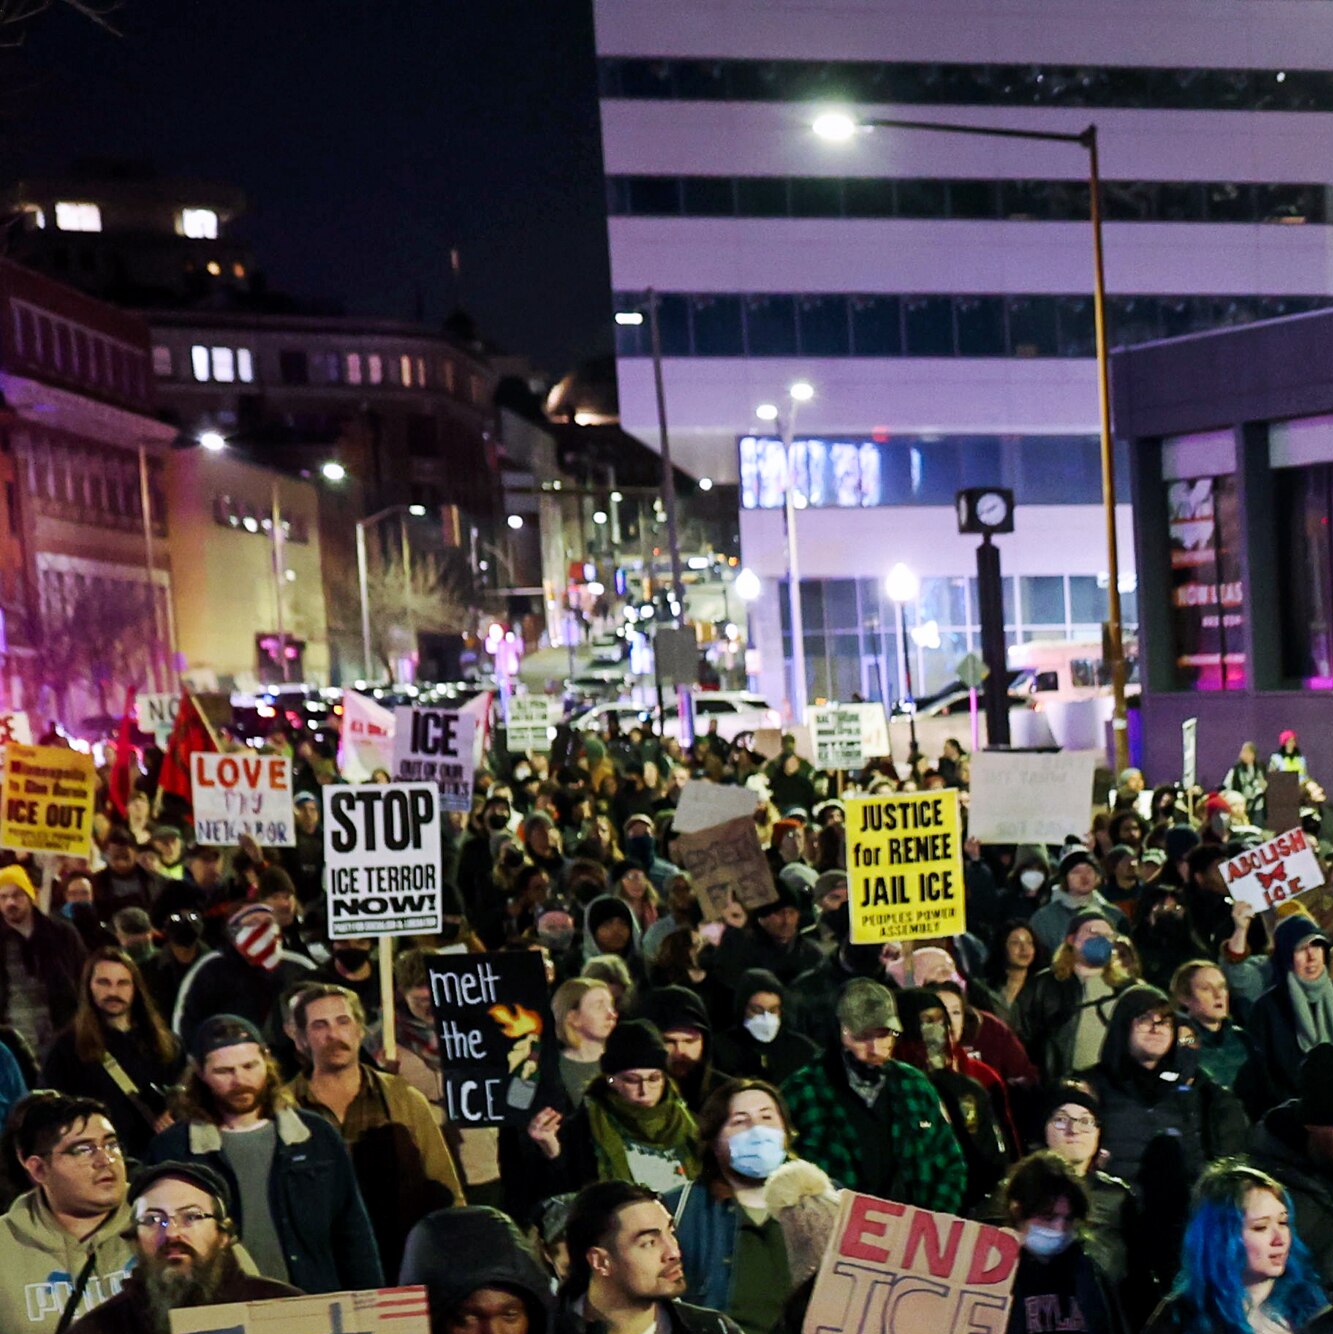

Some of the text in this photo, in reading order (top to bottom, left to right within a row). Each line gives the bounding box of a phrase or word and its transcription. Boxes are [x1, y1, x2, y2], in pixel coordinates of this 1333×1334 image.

[411, 710, 460, 758] ICE
[197, 757, 288, 792] LOVE
[8, 799, 87, 831] ICE OUT
[329, 789, 435, 854] STOP
[860, 800, 944, 832] JUSTICE
[854, 832, 952, 868] for RENEE
[1228, 829, 1307, 884] ABOLISH
[331, 863, 437, 896] ICE TERROR
[861, 871, 955, 908] JAIL ICE
[332, 894, 437, 917] NOW!
[429, 962, 500, 1008] melt
[440, 1020, 488, 1061] the
[837, 1193, 1023, 1287] END
